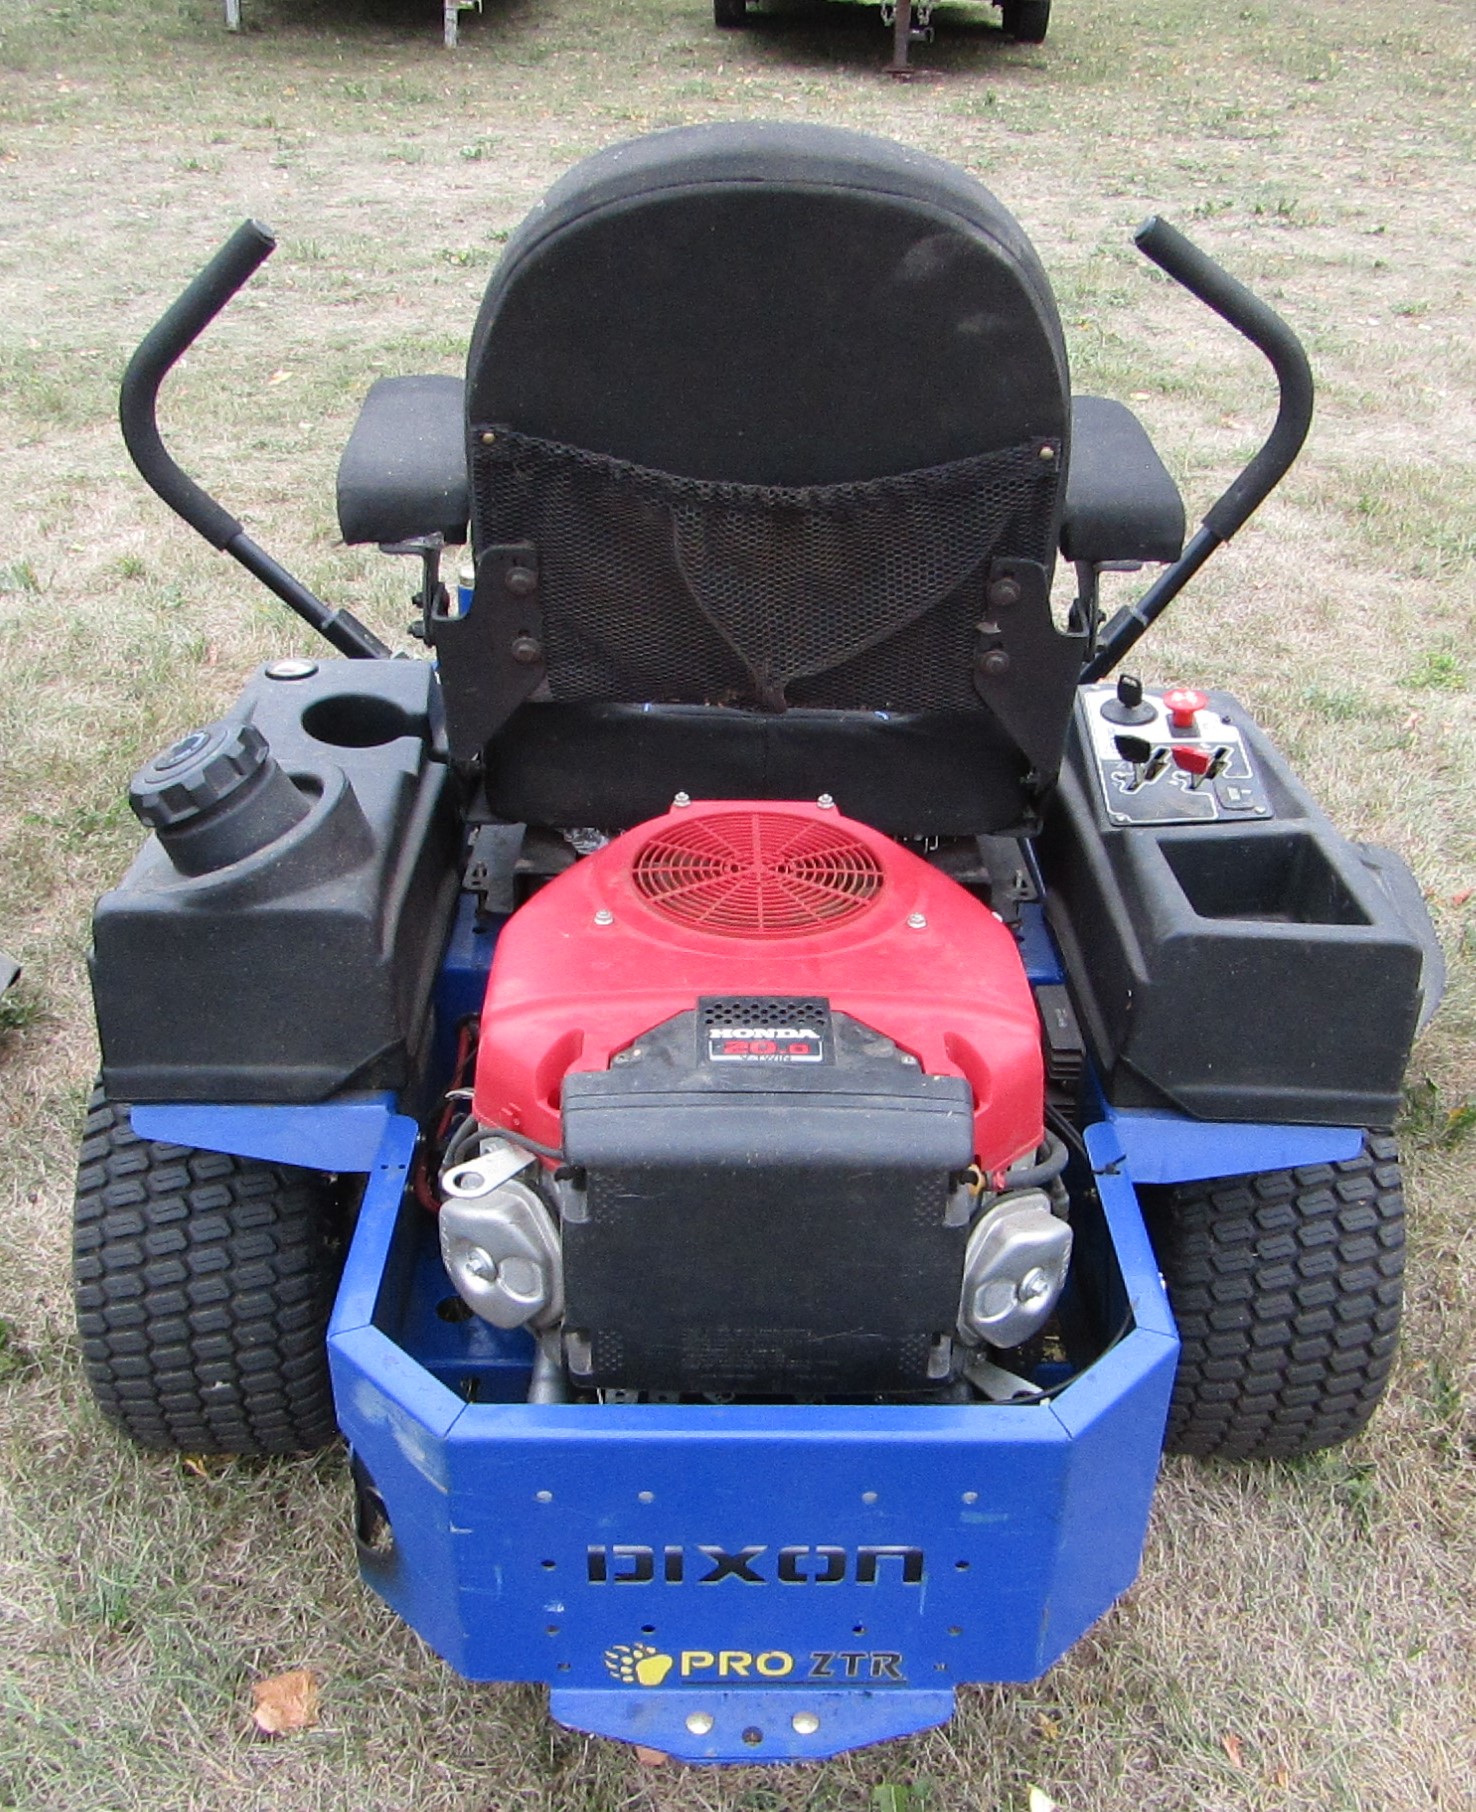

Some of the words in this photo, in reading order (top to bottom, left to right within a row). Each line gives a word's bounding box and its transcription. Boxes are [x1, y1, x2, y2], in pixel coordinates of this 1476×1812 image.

[709, 1028, 820, 1039] HONDA
[722, 1040, 811, 1055] 20.0
[587, 1545, 924, 1585] DIXON
[680, 1650, 795, 1676] PRO
[808, 1651, 906, 1680] ZTR
